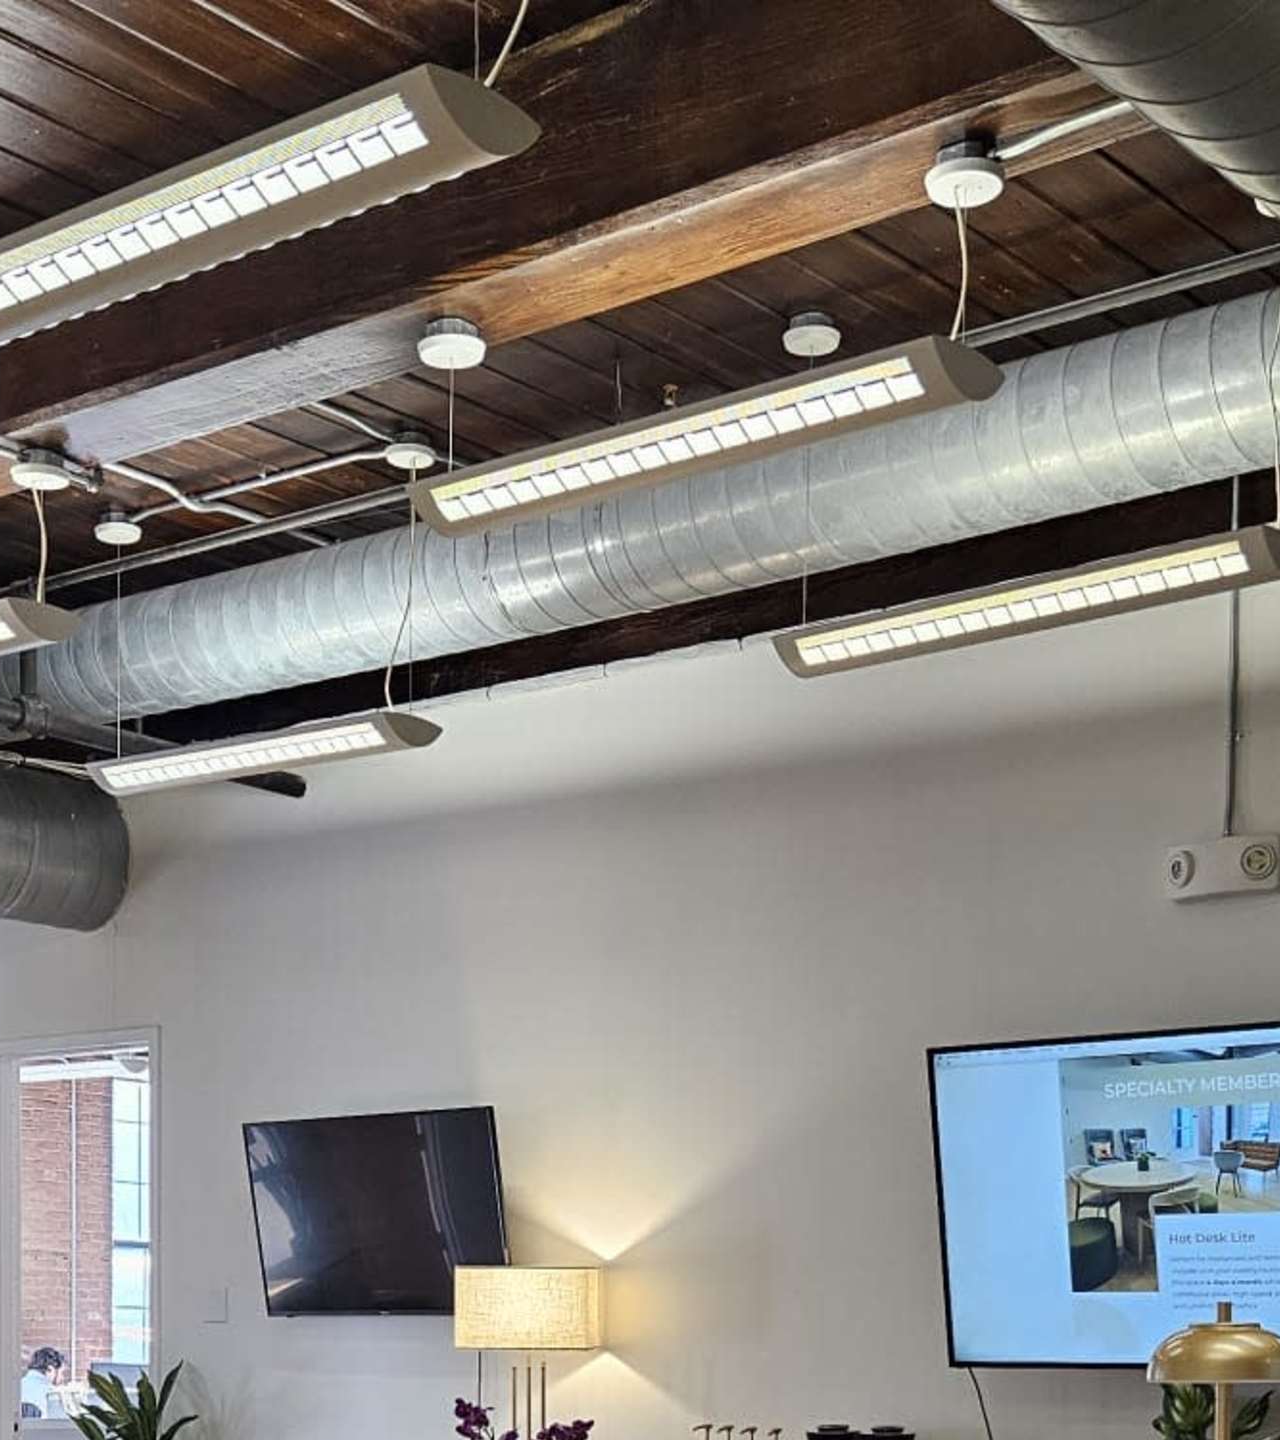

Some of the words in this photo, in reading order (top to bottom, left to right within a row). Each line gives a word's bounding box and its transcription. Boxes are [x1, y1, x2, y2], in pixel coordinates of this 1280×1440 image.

[1104, 1078, 1195, 1099] SPECIALTY
[1169, 1233, 1192, 1245] Hot
[1196, 1233, 1227, 1244] Desk
